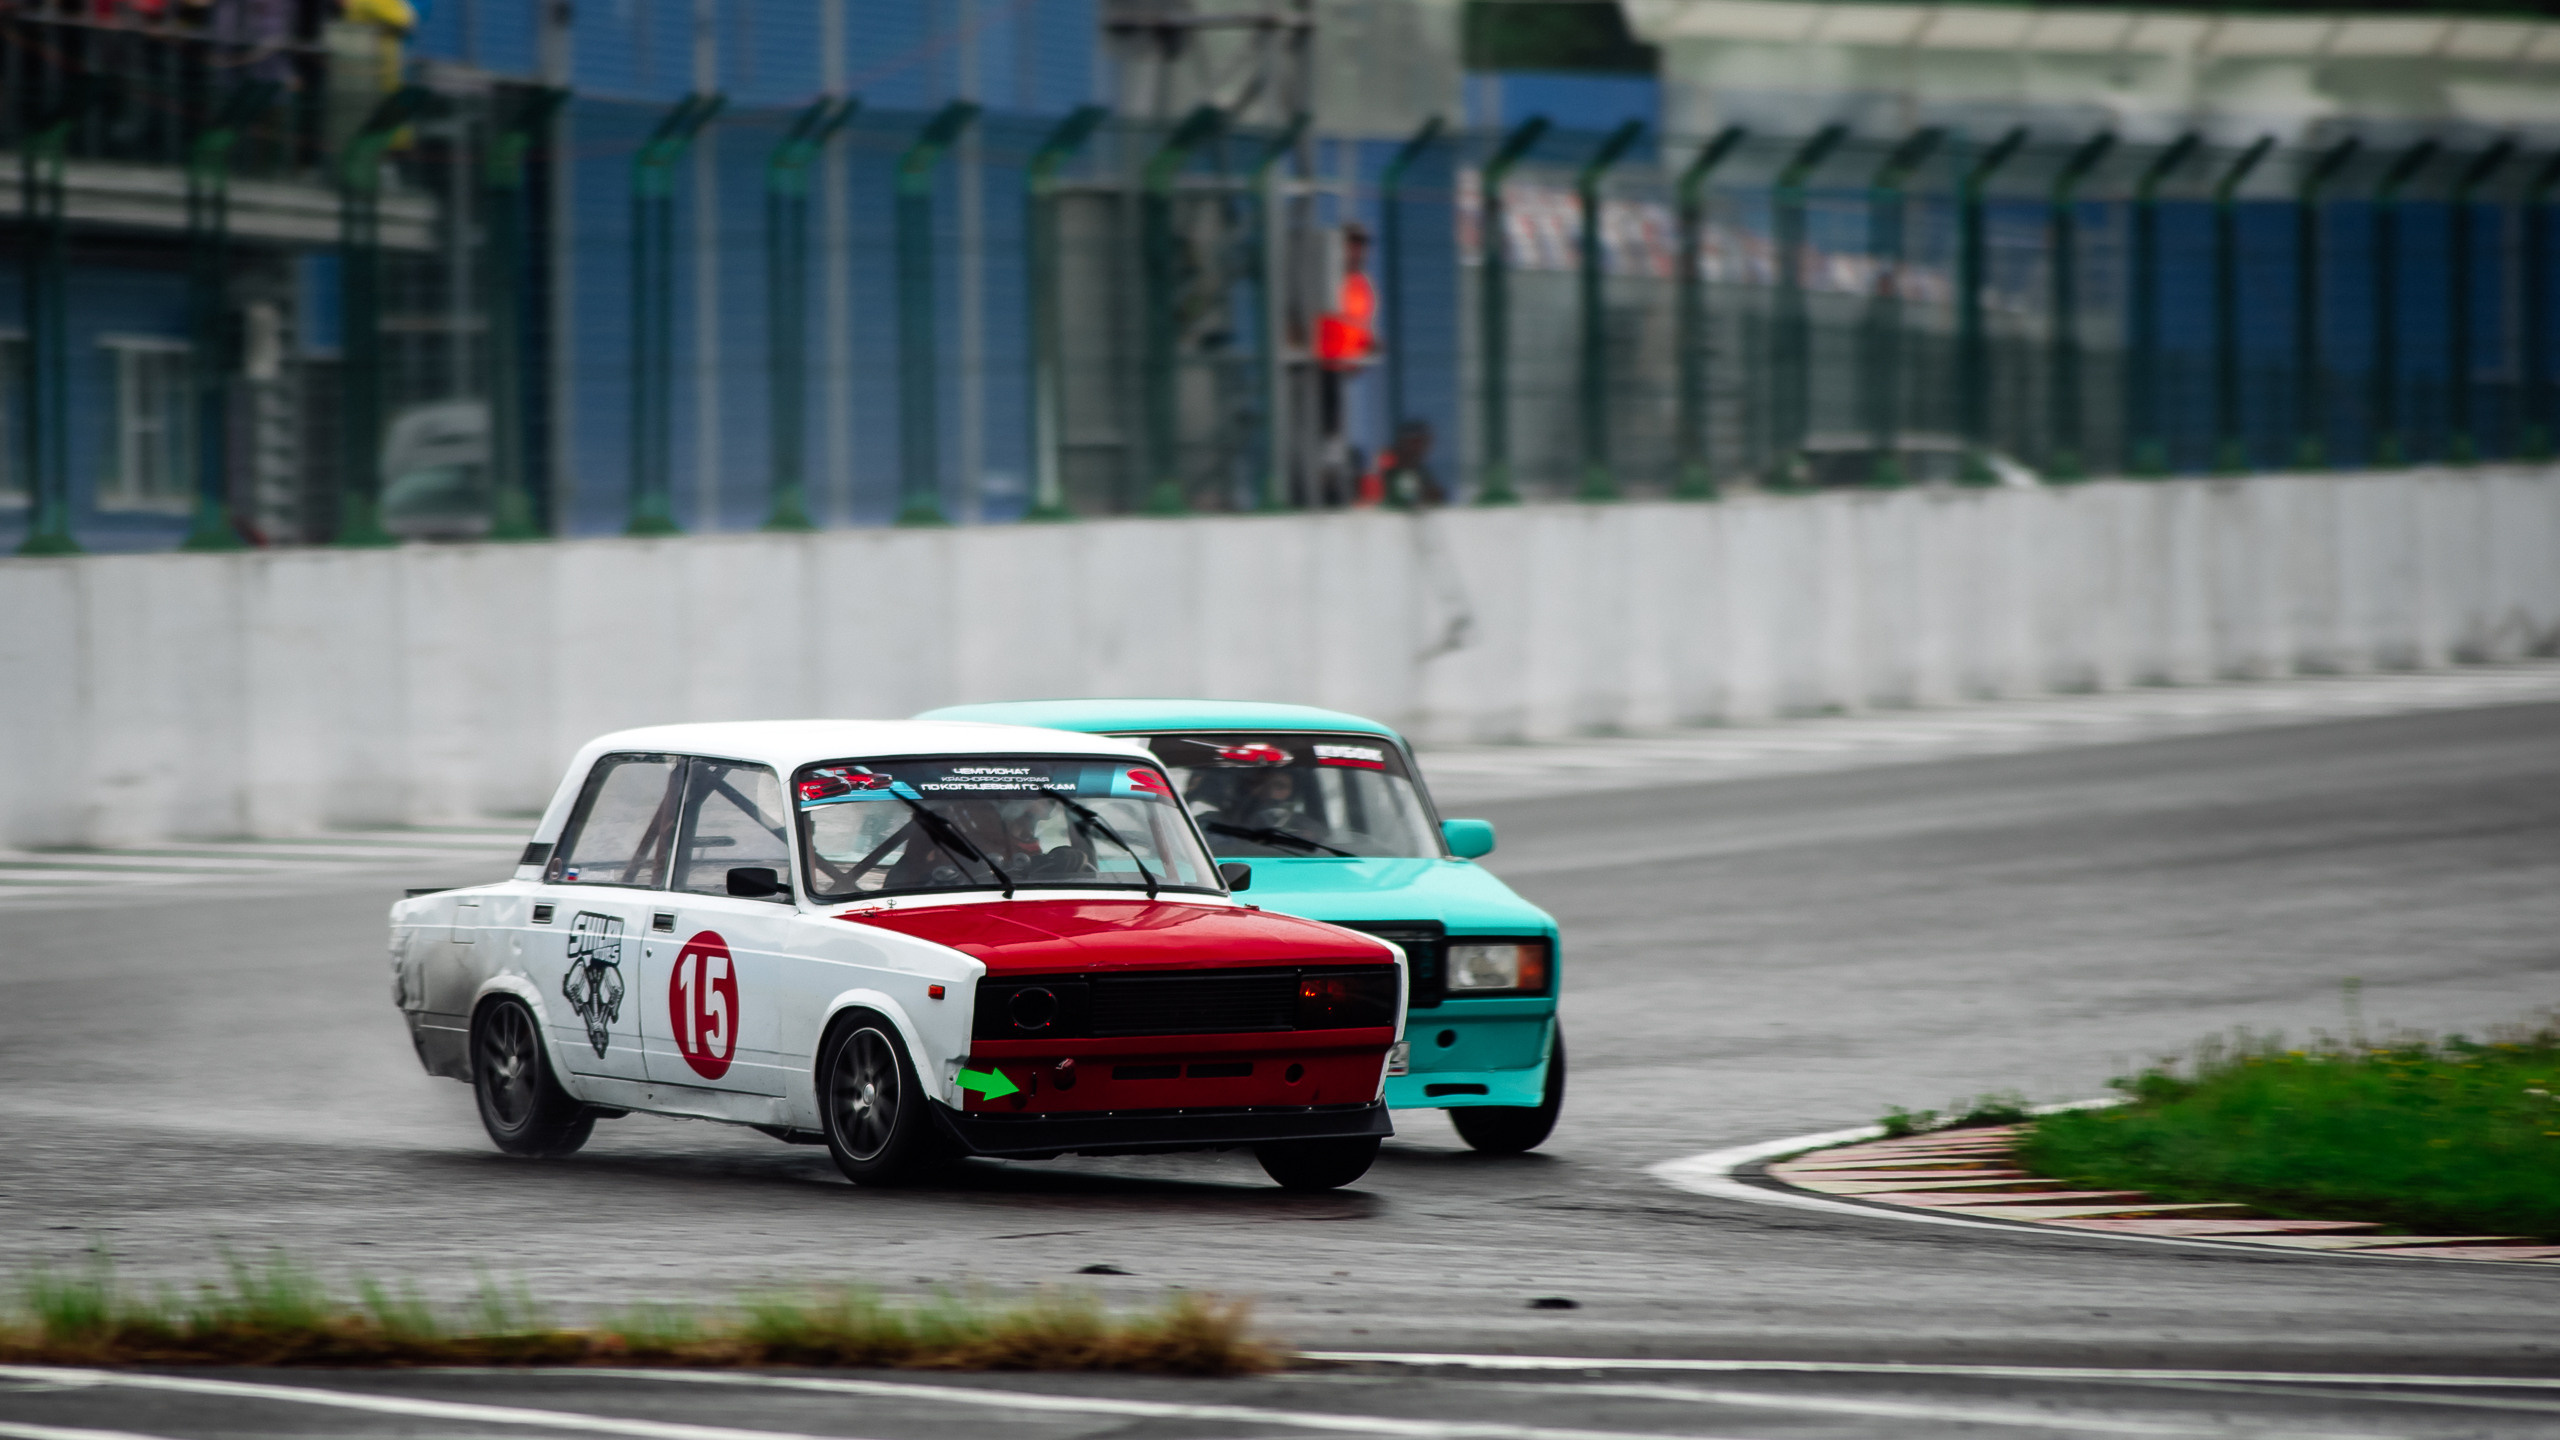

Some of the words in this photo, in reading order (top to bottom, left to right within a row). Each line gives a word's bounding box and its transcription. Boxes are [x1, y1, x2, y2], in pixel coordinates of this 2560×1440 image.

[953, 767, 1031, 775] ЧЕМПИОНАТ
[921, 783, 939, 791] ПО
[940, 783, 1020, 791] КОЛЬЦЕВЫМ
[680, 954, 728, 1059] 15
